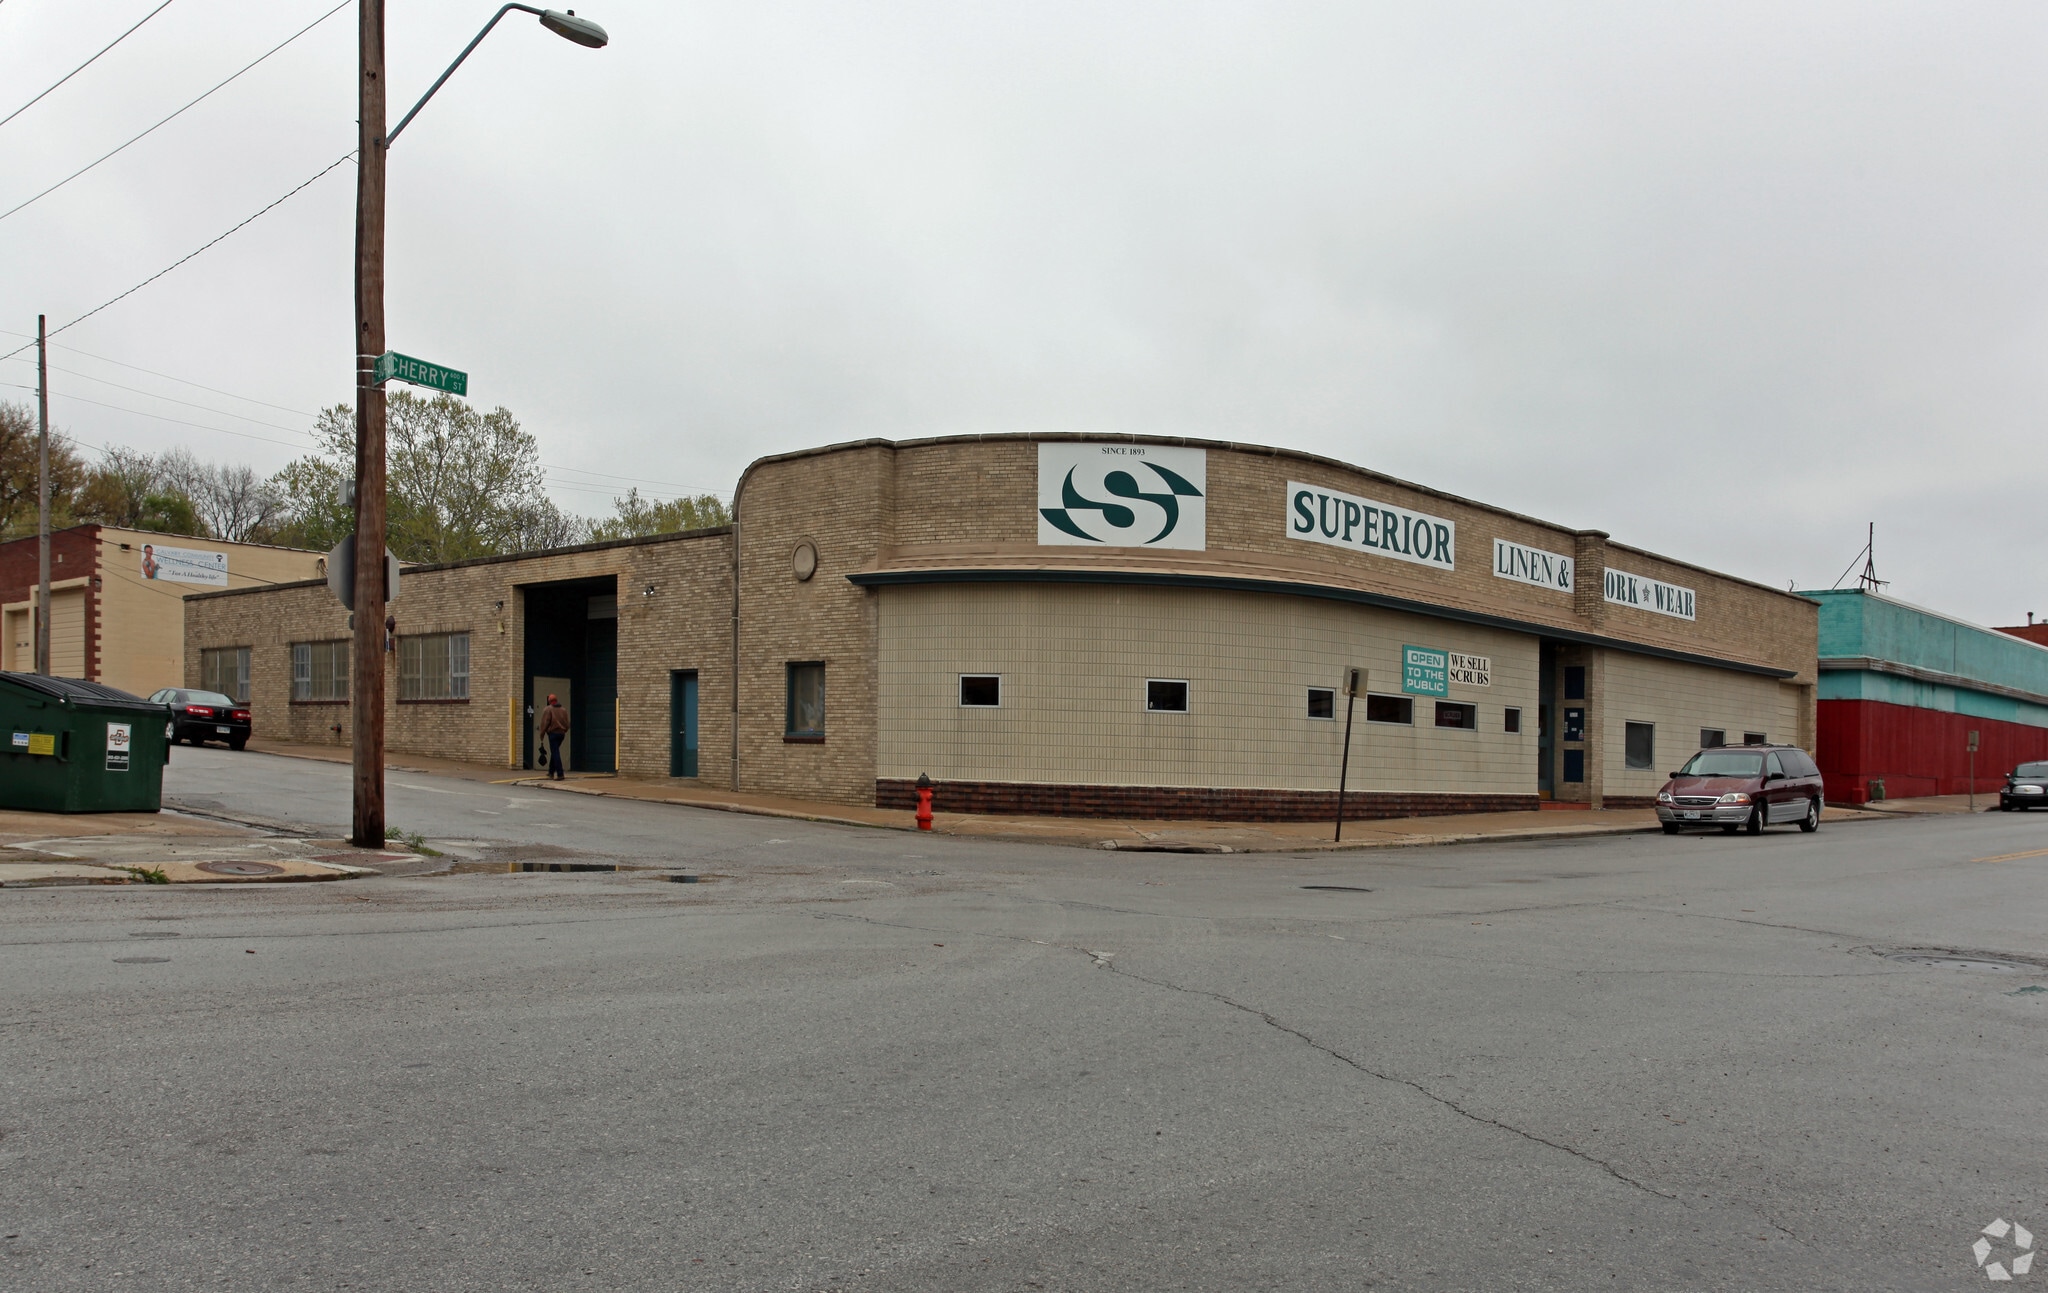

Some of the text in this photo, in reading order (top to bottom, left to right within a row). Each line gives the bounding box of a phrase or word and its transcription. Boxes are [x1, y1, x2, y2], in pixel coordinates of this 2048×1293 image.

[392, 356, 448, 387] CHERRY
[452, 381, 463, 392] ST
[1101, 447, 1146, 456] SINCE 1893
[1294, 490, 1453, 564] SUPERIOR
[156, 556, 226, 570] WELLNESS CENTER
[1497, 543, 1569, 588] LINEN &
[1605, 571, 1693, 617] ORK WEAR
[1411, 653, 1441, 666] OPEN
[1451, 654, 1488, 671] WE SELL
[1408, 667, 1444, 680] TO THE
[1450, 668, 1489, 686] SCRUBS
[1407, 678, 1444, 691] PUBLIC
